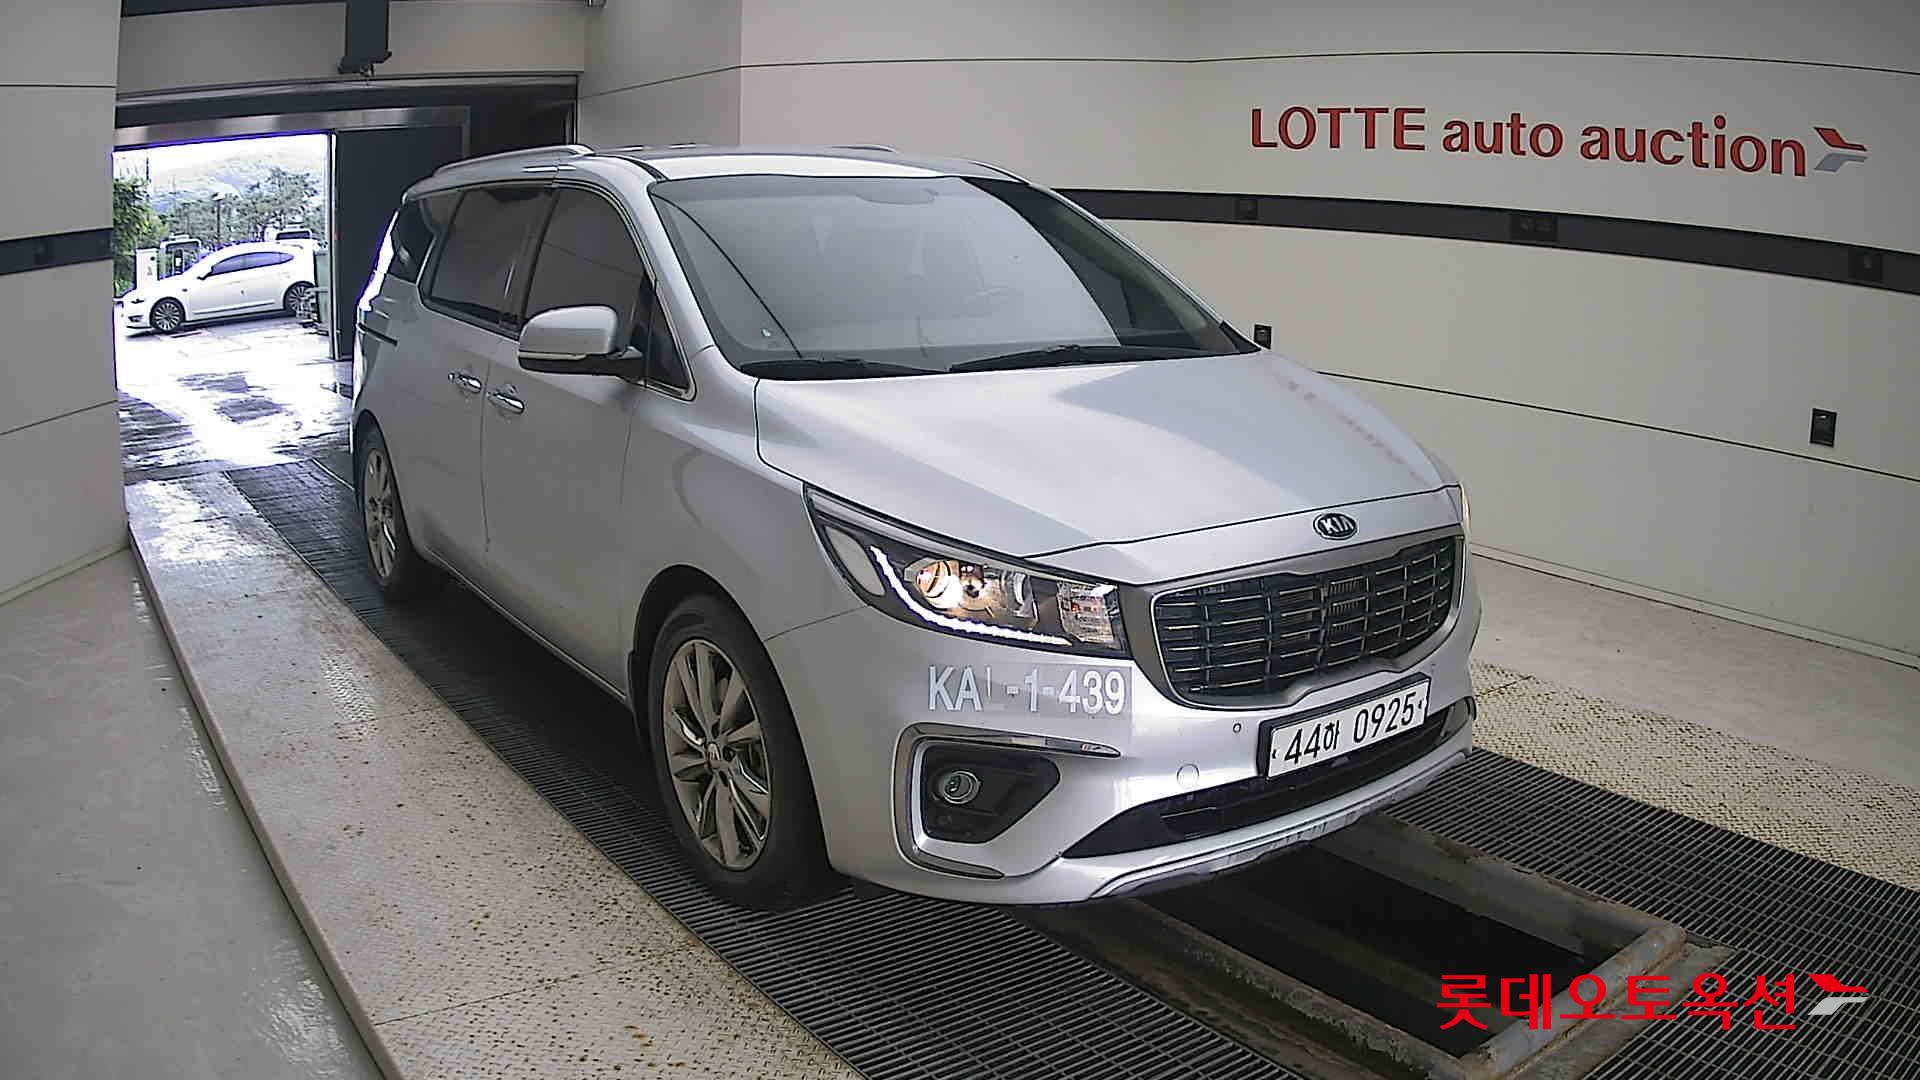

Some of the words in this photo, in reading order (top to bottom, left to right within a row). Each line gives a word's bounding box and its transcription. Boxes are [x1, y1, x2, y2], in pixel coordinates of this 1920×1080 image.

[1250, 107, 1427, 152] LOTTE
[1442, 112, 1564, 159] auto
[1580, 115, 1806, 177] auction
[1320, 515, 1355, 534] KIA
[1284, 719, 1340, 764] 44하
[1353, 691, 1417, 743] 0925
